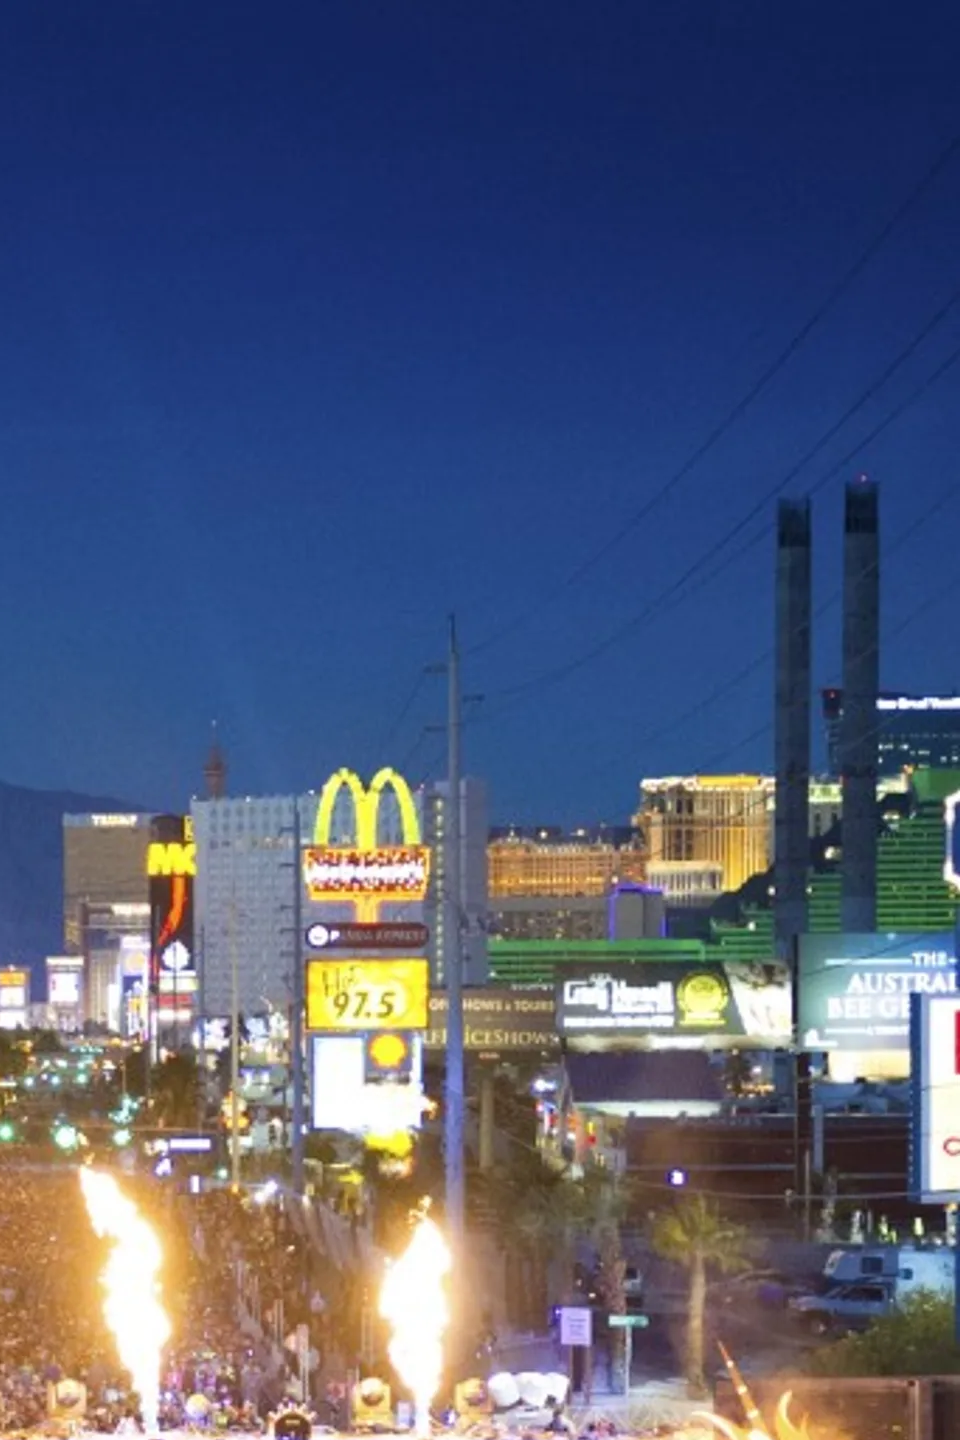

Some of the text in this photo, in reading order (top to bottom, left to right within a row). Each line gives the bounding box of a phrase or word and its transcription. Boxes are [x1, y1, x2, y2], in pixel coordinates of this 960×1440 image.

[912, 951, 948, 966] THE
[333, 991, 397, 1018] 97.5
[827, 997, 871, 1019] BEE
